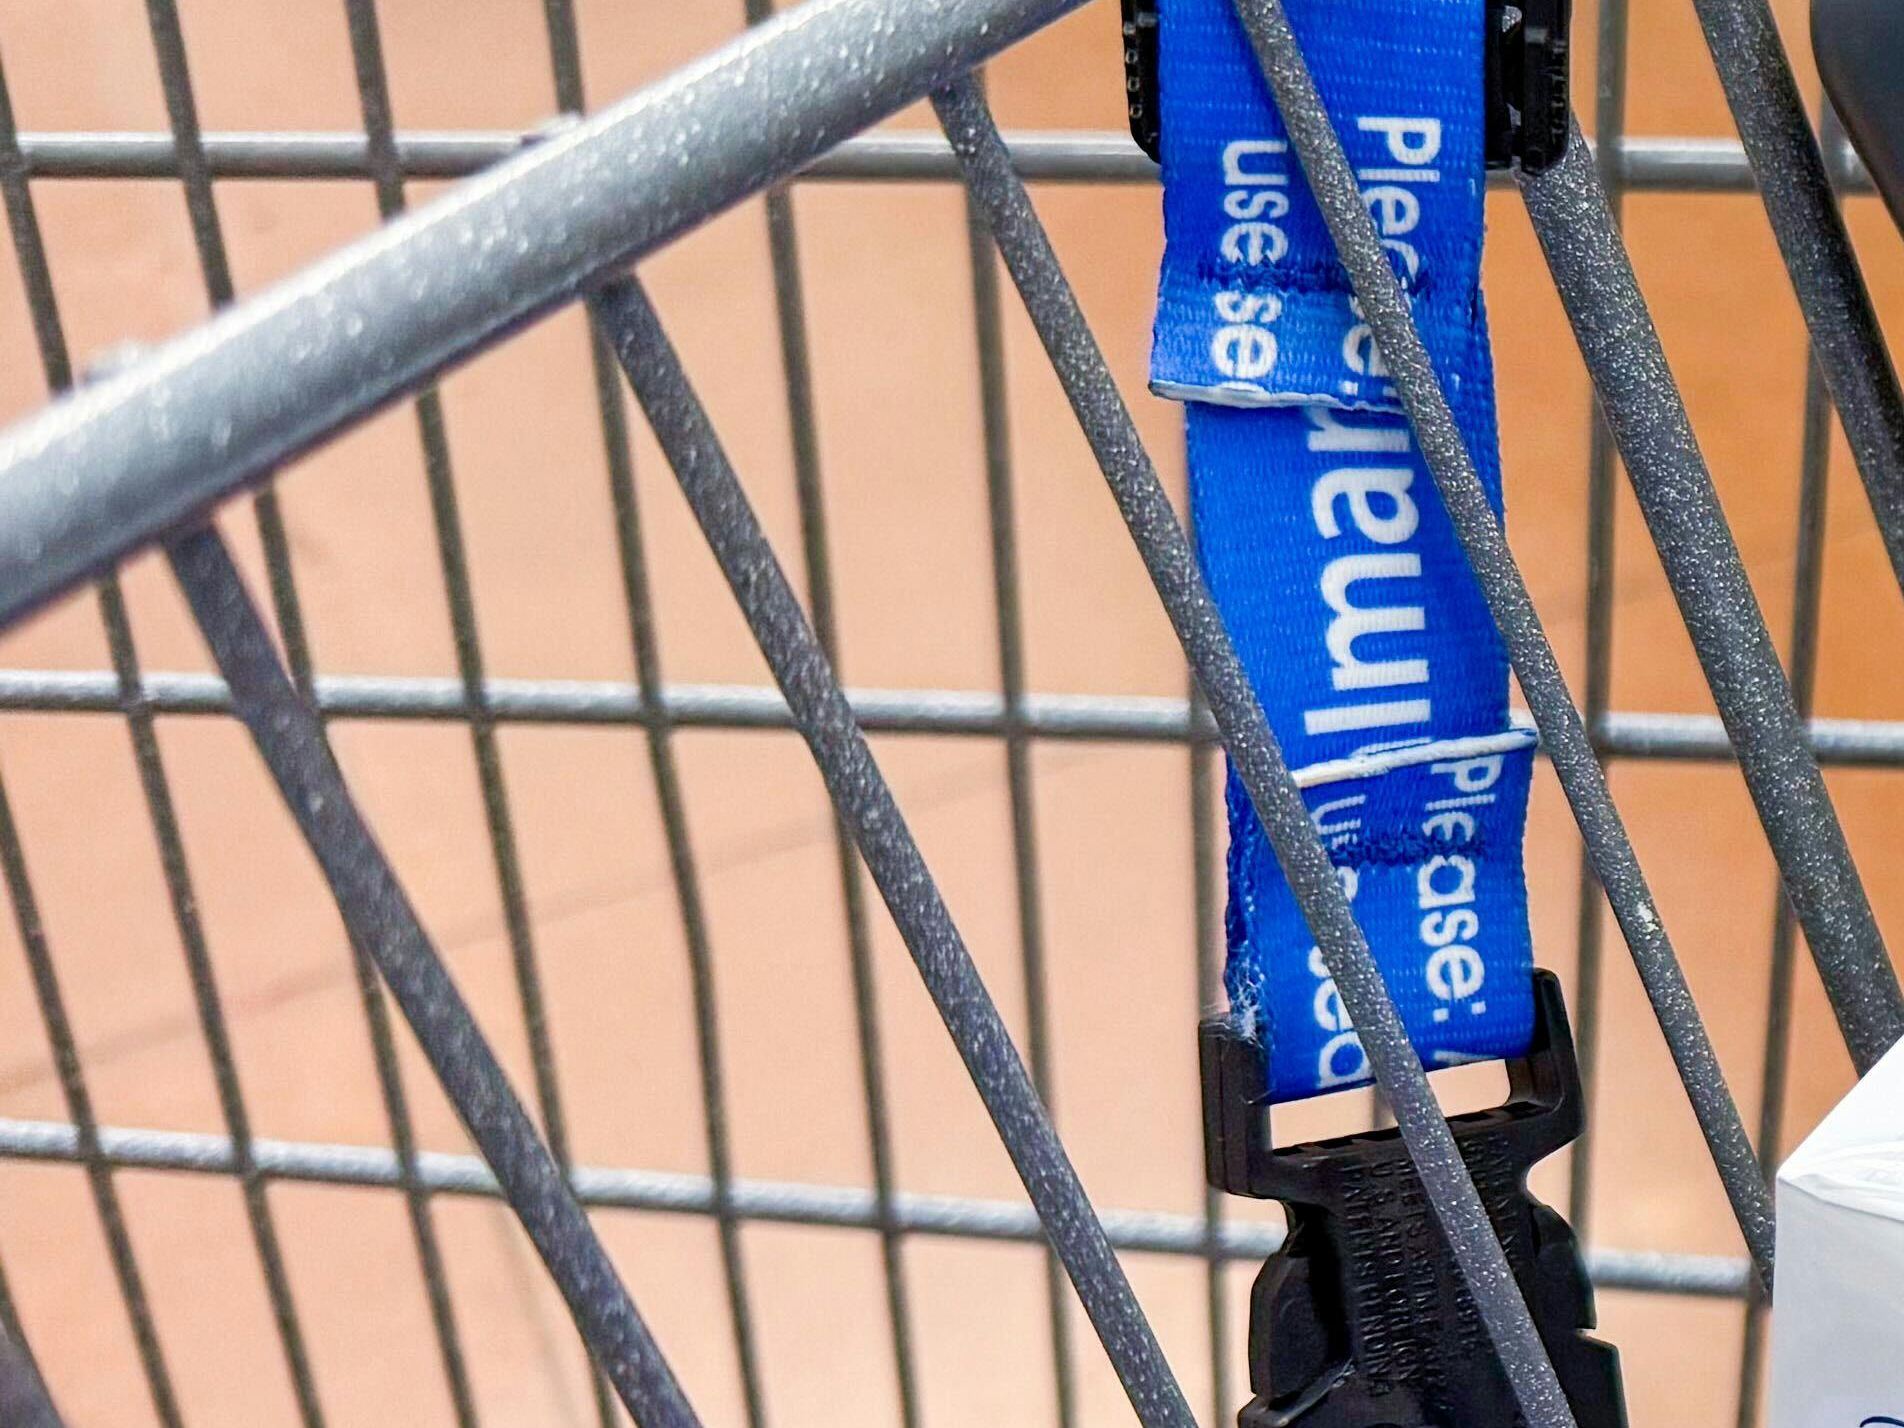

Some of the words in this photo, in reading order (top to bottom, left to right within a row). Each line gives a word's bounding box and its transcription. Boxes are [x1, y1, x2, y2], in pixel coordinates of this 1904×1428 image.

[1219, 139, 1290, 267] use
[1342, 116, 1442, 397] Plee:
[1416, 752, 1506, 1024] Please:
